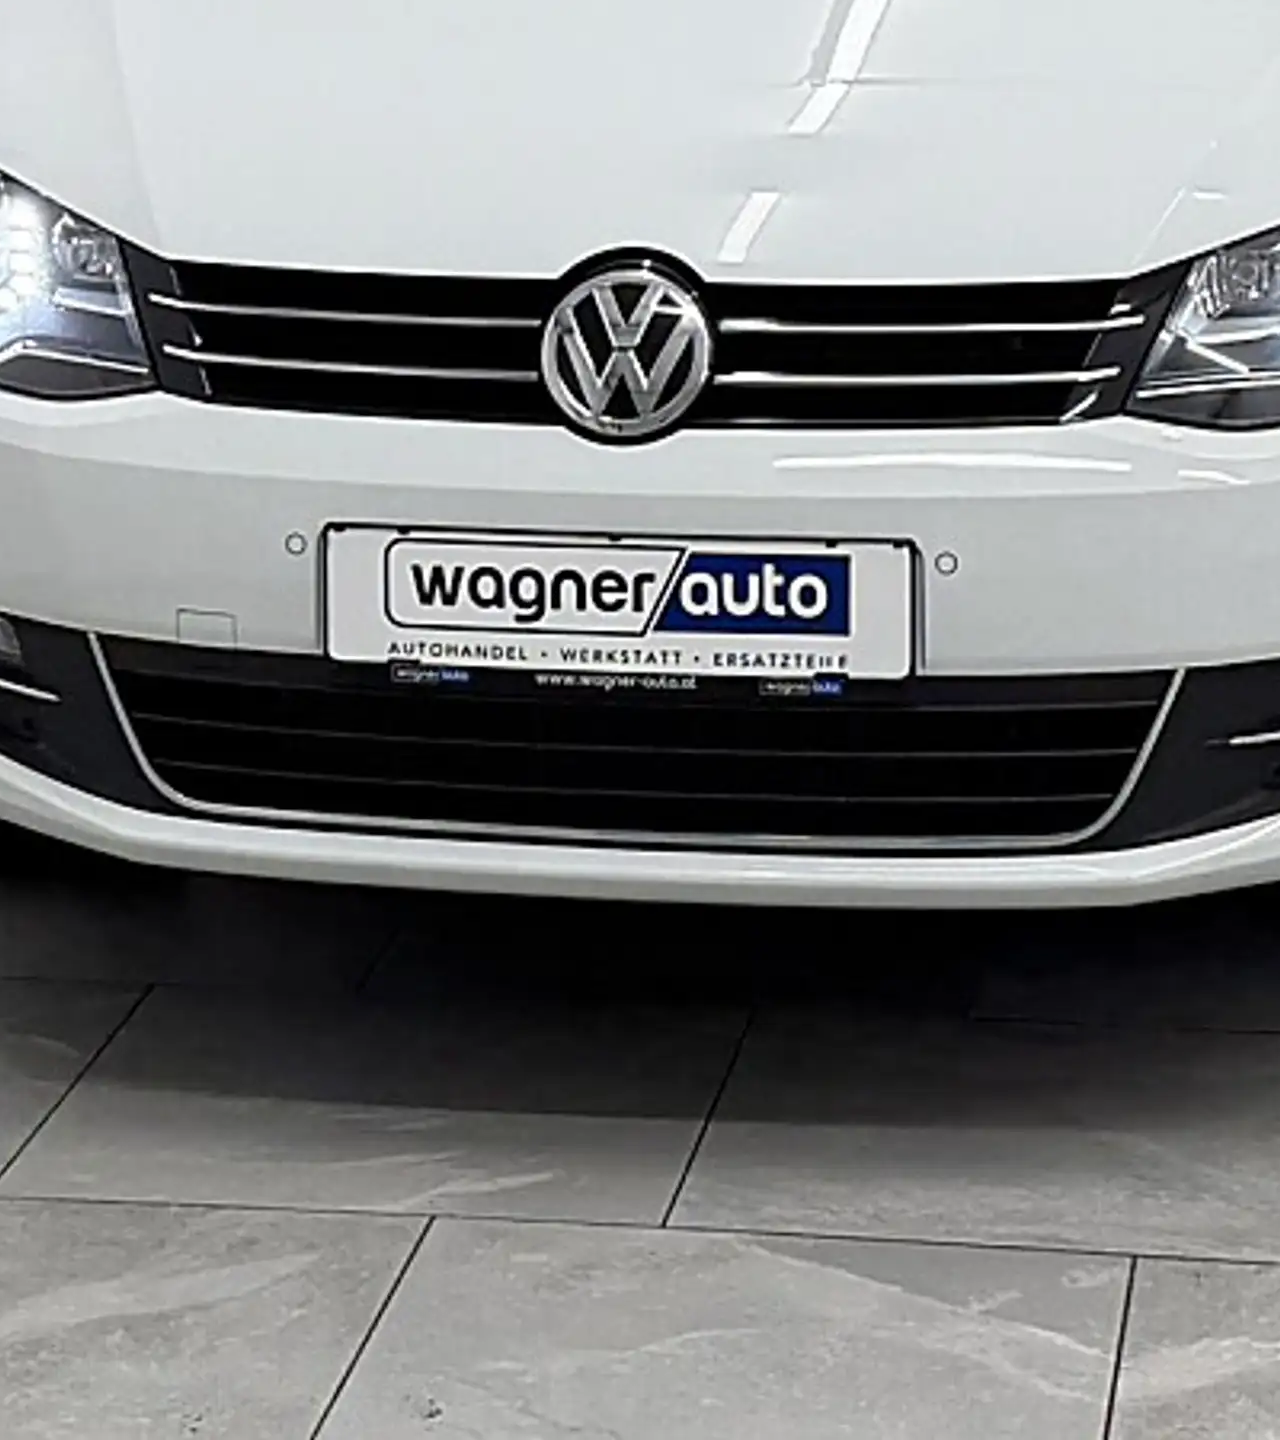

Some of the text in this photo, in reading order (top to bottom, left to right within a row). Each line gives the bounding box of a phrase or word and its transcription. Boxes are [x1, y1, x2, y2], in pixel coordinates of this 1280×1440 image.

[550, 276, 700, 426] VW
[410, 561, 828, 623] wagner auto
[387, 641, 528, 661] AUTOHANDEL
[560, 647, 682, 665] WERKSTATT
